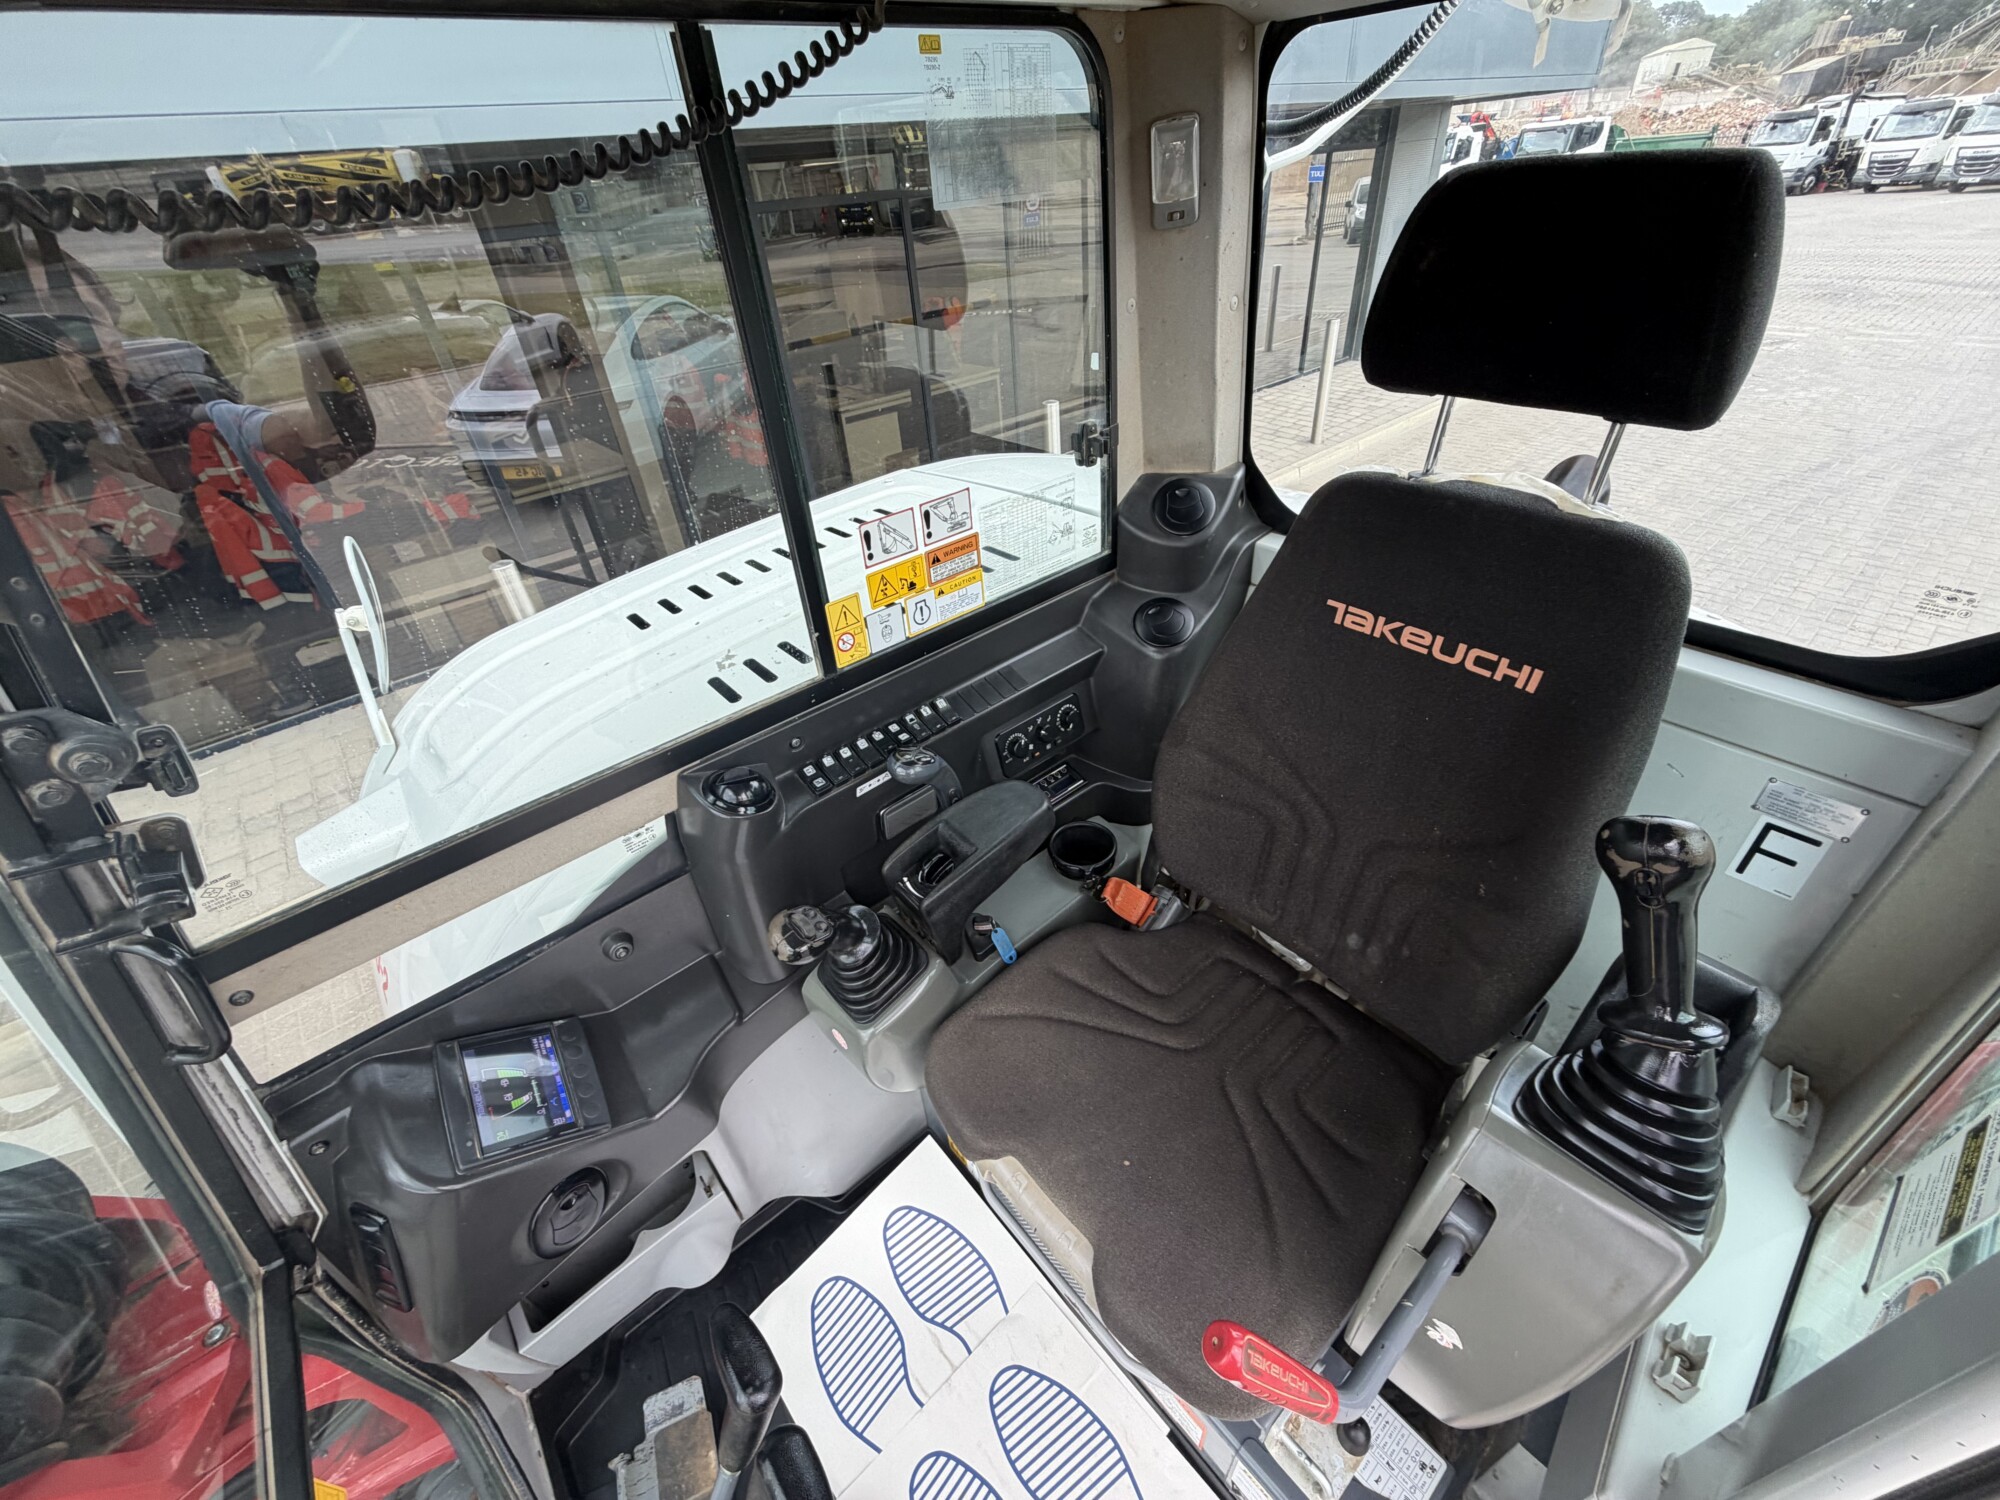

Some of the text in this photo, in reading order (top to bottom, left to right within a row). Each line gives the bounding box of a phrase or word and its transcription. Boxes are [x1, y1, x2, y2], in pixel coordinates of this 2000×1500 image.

[943, 541, 974, 558] WARNING
[949, 575, 977, 590] CAUTION
[1735, 821, 1823, 875] F
